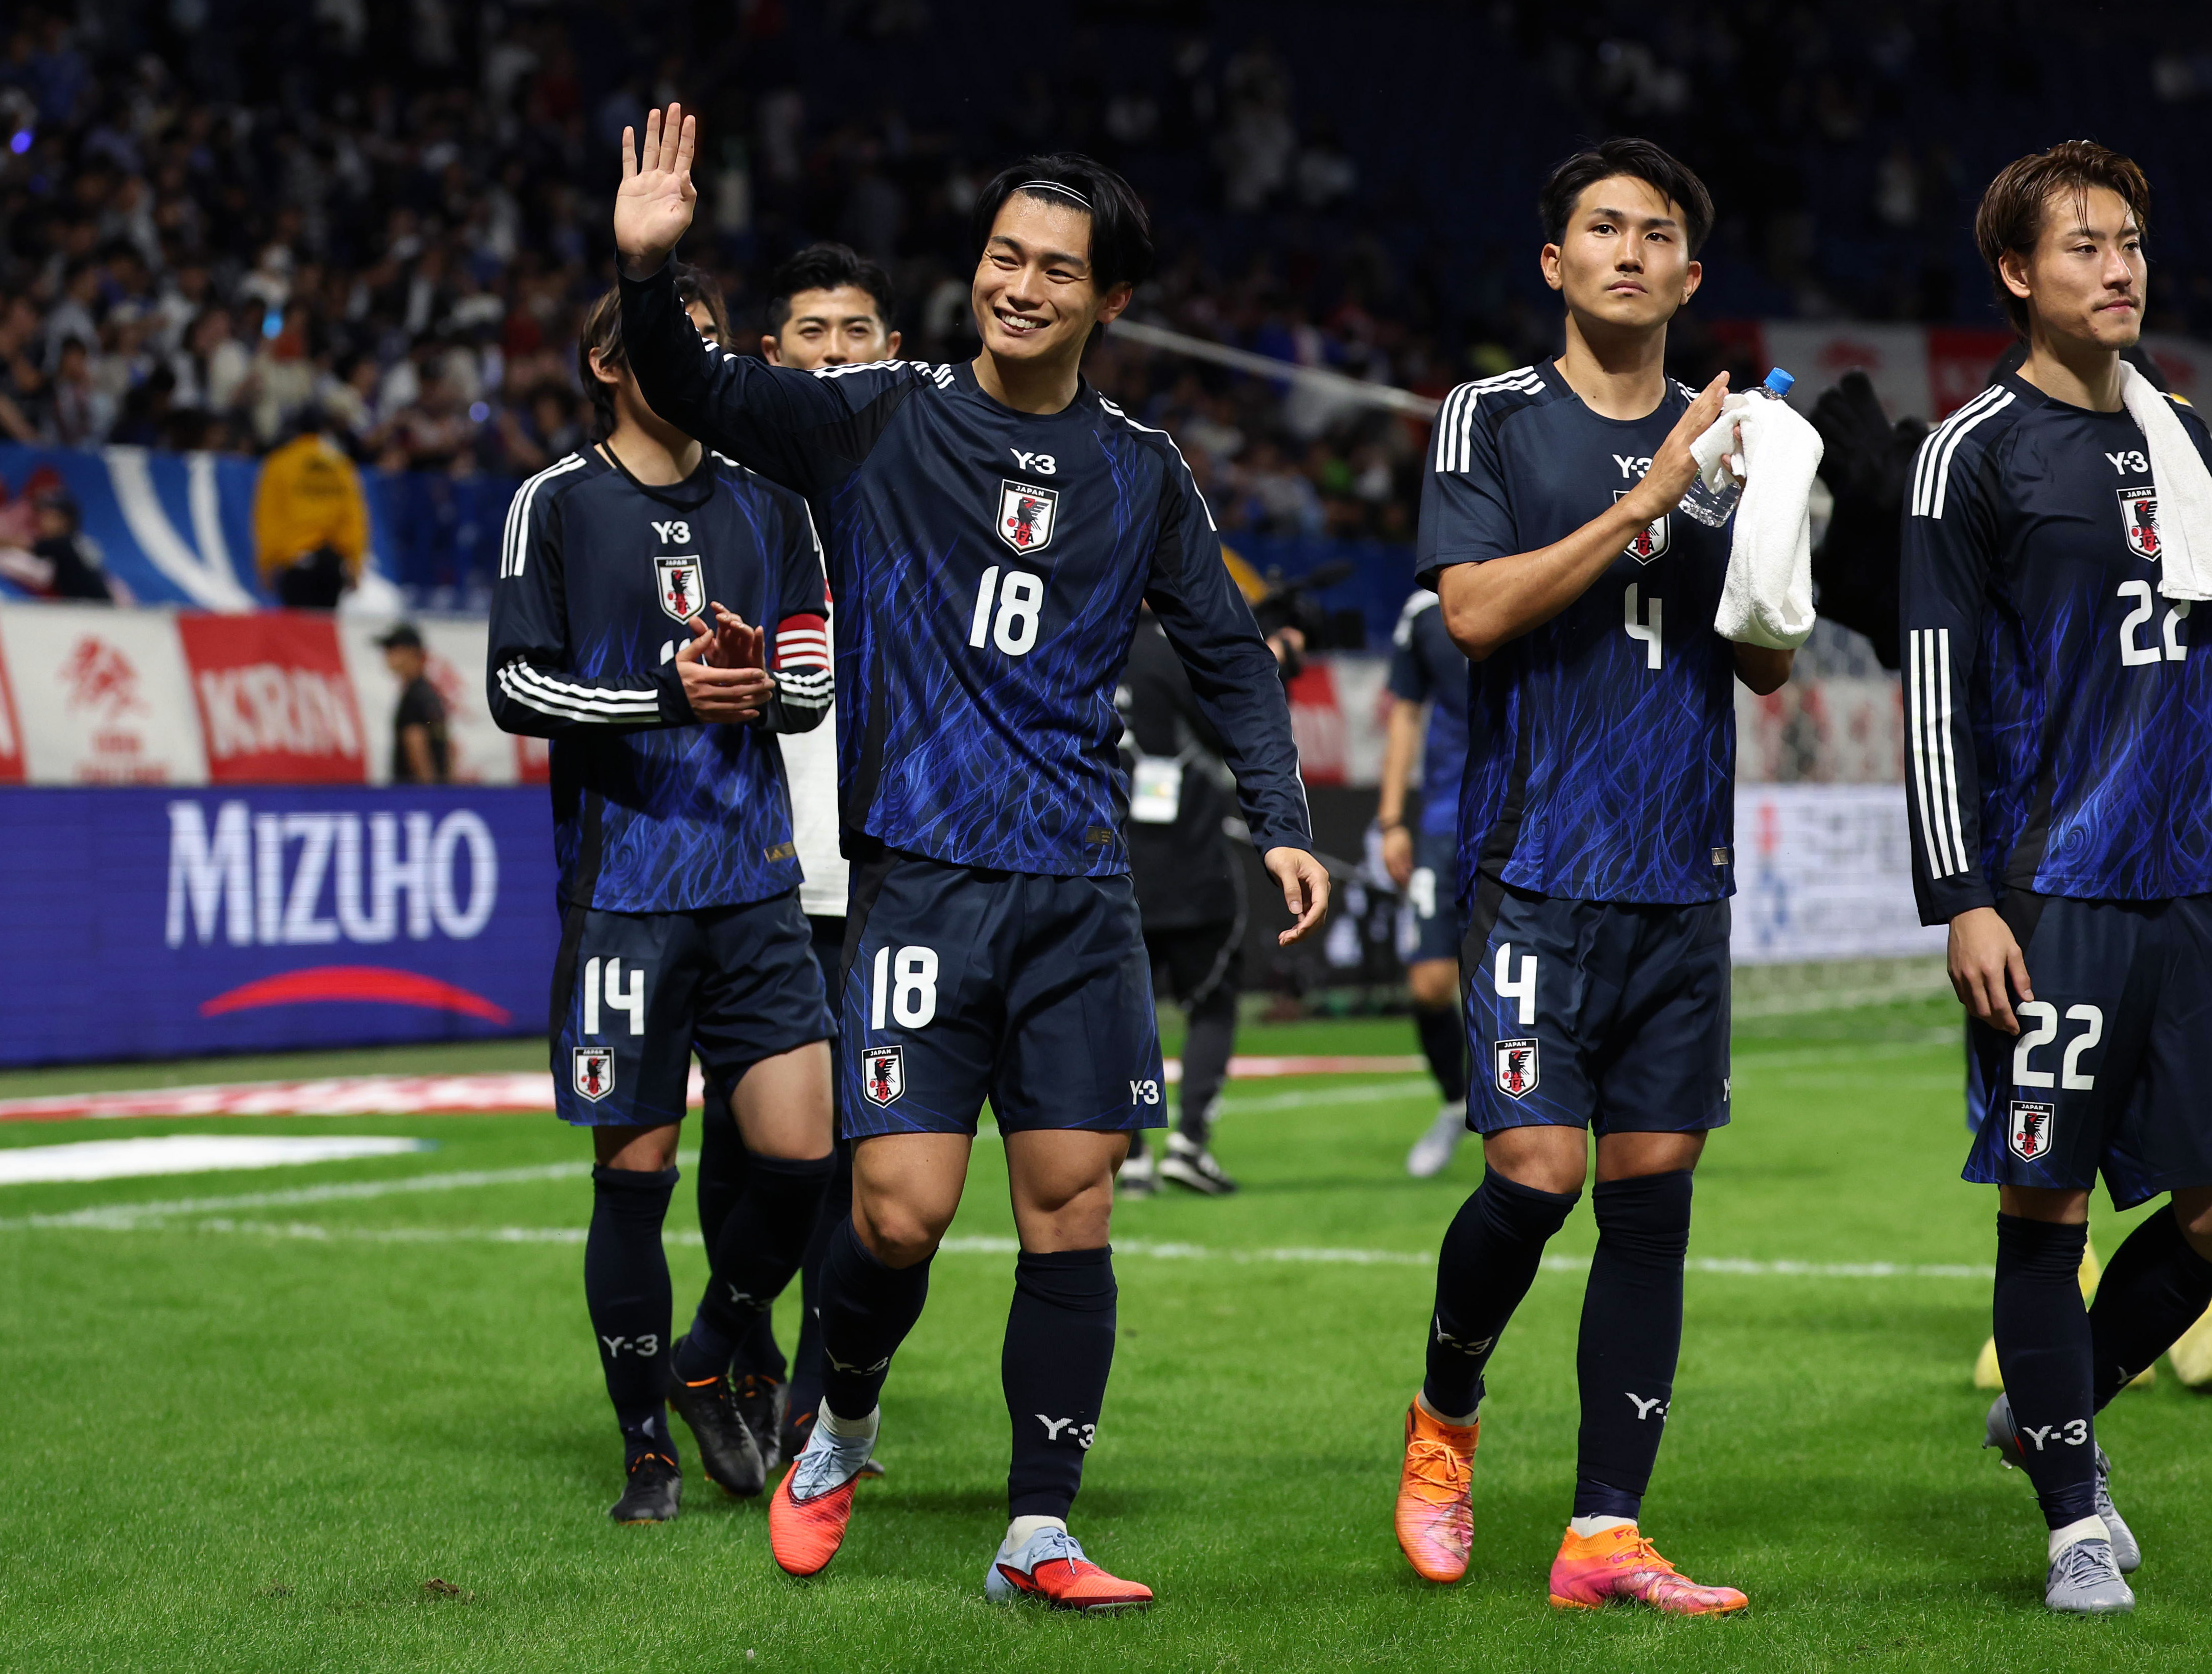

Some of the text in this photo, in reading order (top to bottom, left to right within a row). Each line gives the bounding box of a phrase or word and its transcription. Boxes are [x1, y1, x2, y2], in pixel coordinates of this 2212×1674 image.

[1010, 448, 1057, 475] Y-3
[2105, 450, 2149, 475] Y-3
[1015, 486, 1044, 496] JAPAN
[2127, 490, 2152, 498] JAPAN
[651, 521, 691, 544] Y-3
[1010, 529, 1034, 543] JFA
[1632, 539, 1655, 551] JFA
[2138, 536, 2161, 548] JFA
[969, 565, 1043, 656] 18
[1625, 582, 1662, 669] 4
[164, 799, 498, 949] MIZUHO
[584, 956, 645, 1036] 14
[871, 946, 939, 1030] 18
[1494, 943, 1538, 1024] 4
[2013, 1000, 2103, 1090] 22
[874, 1087, 892, 1097] JFA
[1130, 1080, 1159, 1105] Y-3
[1507, 1079, 1526, 1088] JFA
[2019, 1141, 2039, 1152] JFA
[602, 1334, 658, 1358] Y-3
[1035, 1414, 1096, 1449] Y-3
[2023, 1419, 2088, 1451] Y-3
